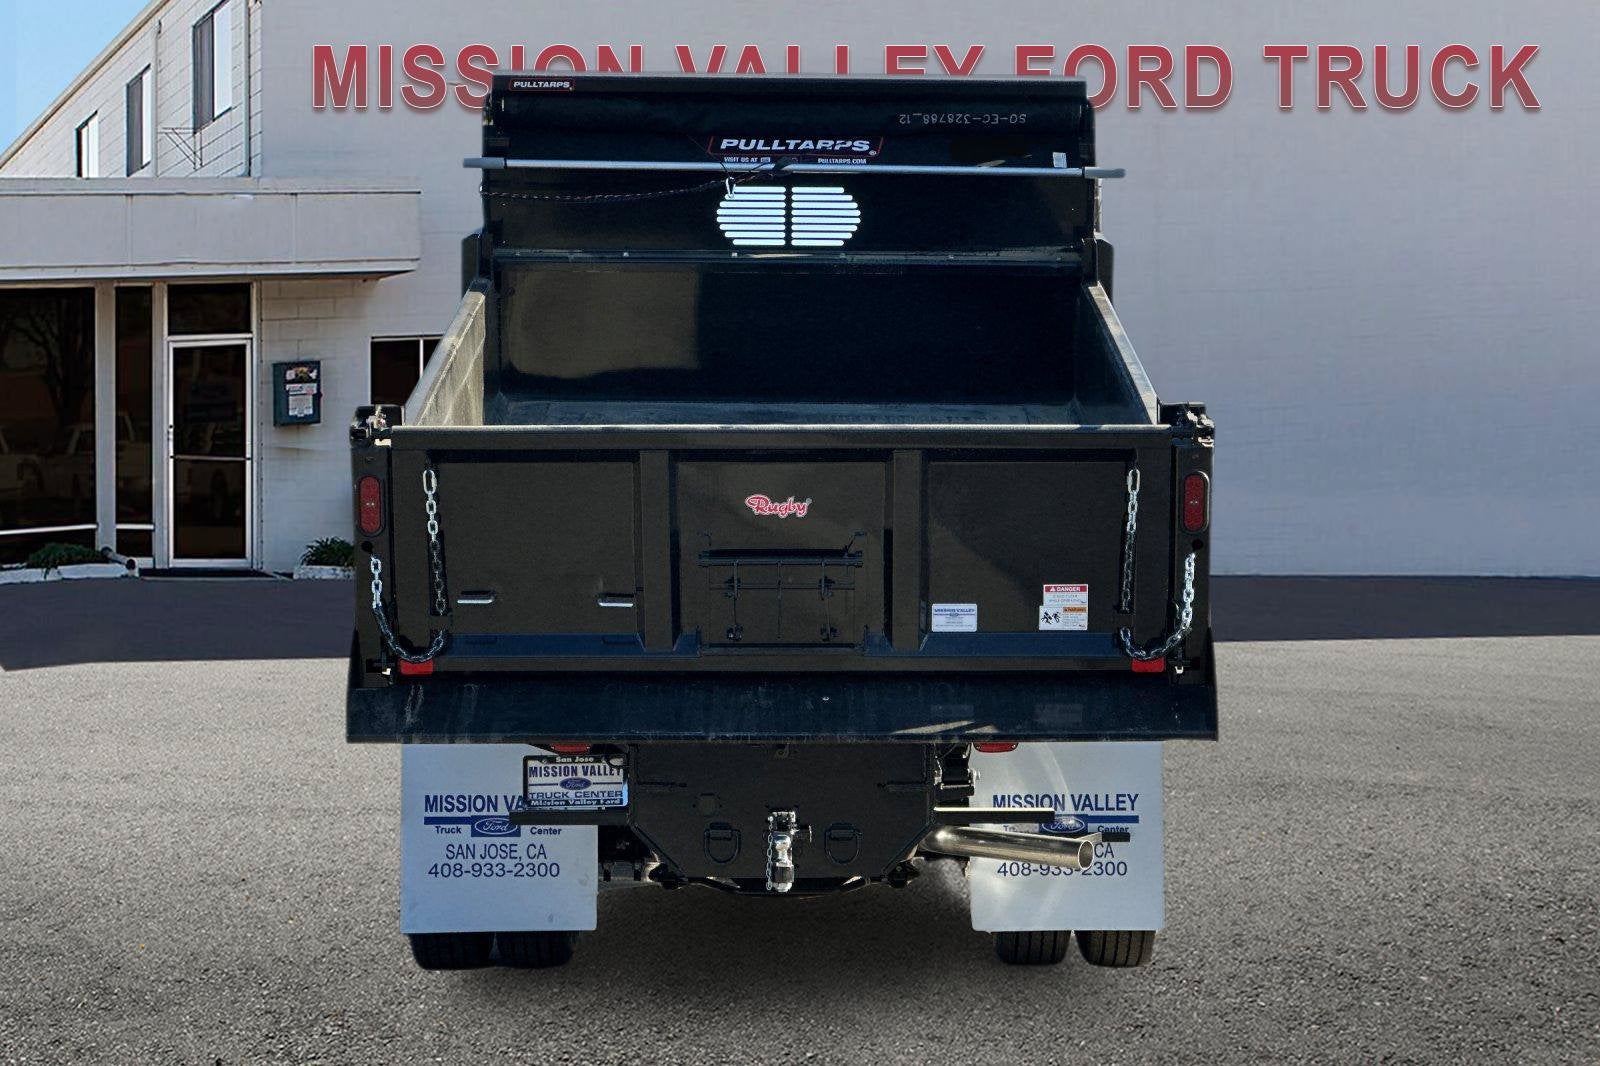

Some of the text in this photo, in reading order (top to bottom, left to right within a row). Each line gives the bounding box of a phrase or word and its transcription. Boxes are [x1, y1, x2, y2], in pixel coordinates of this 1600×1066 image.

[1014, 43, 1233, 109] FORD
[1263, 43, 1541, 109] TRUCK
[745, 494, 809, 518] Rugby
[529, 765, 578, 777] MISSION
[563, 779, 588, 789] Ford
[575, 790, 623, 798] CENTER
[424, 795, 498, 812] MISSION
[569, 799, 597, 807] Valley
[992, 793, 1140, 811] MISSION VALLEY
[435, 826, 562, 835] Truck Center
[479, 819, 512, 834] Ford
[445, 843, 547, 862] SAN JOSE, CA
[1094, 842, 1115, 859] CA
[428, 863, 560, 878] 408-933-2300
